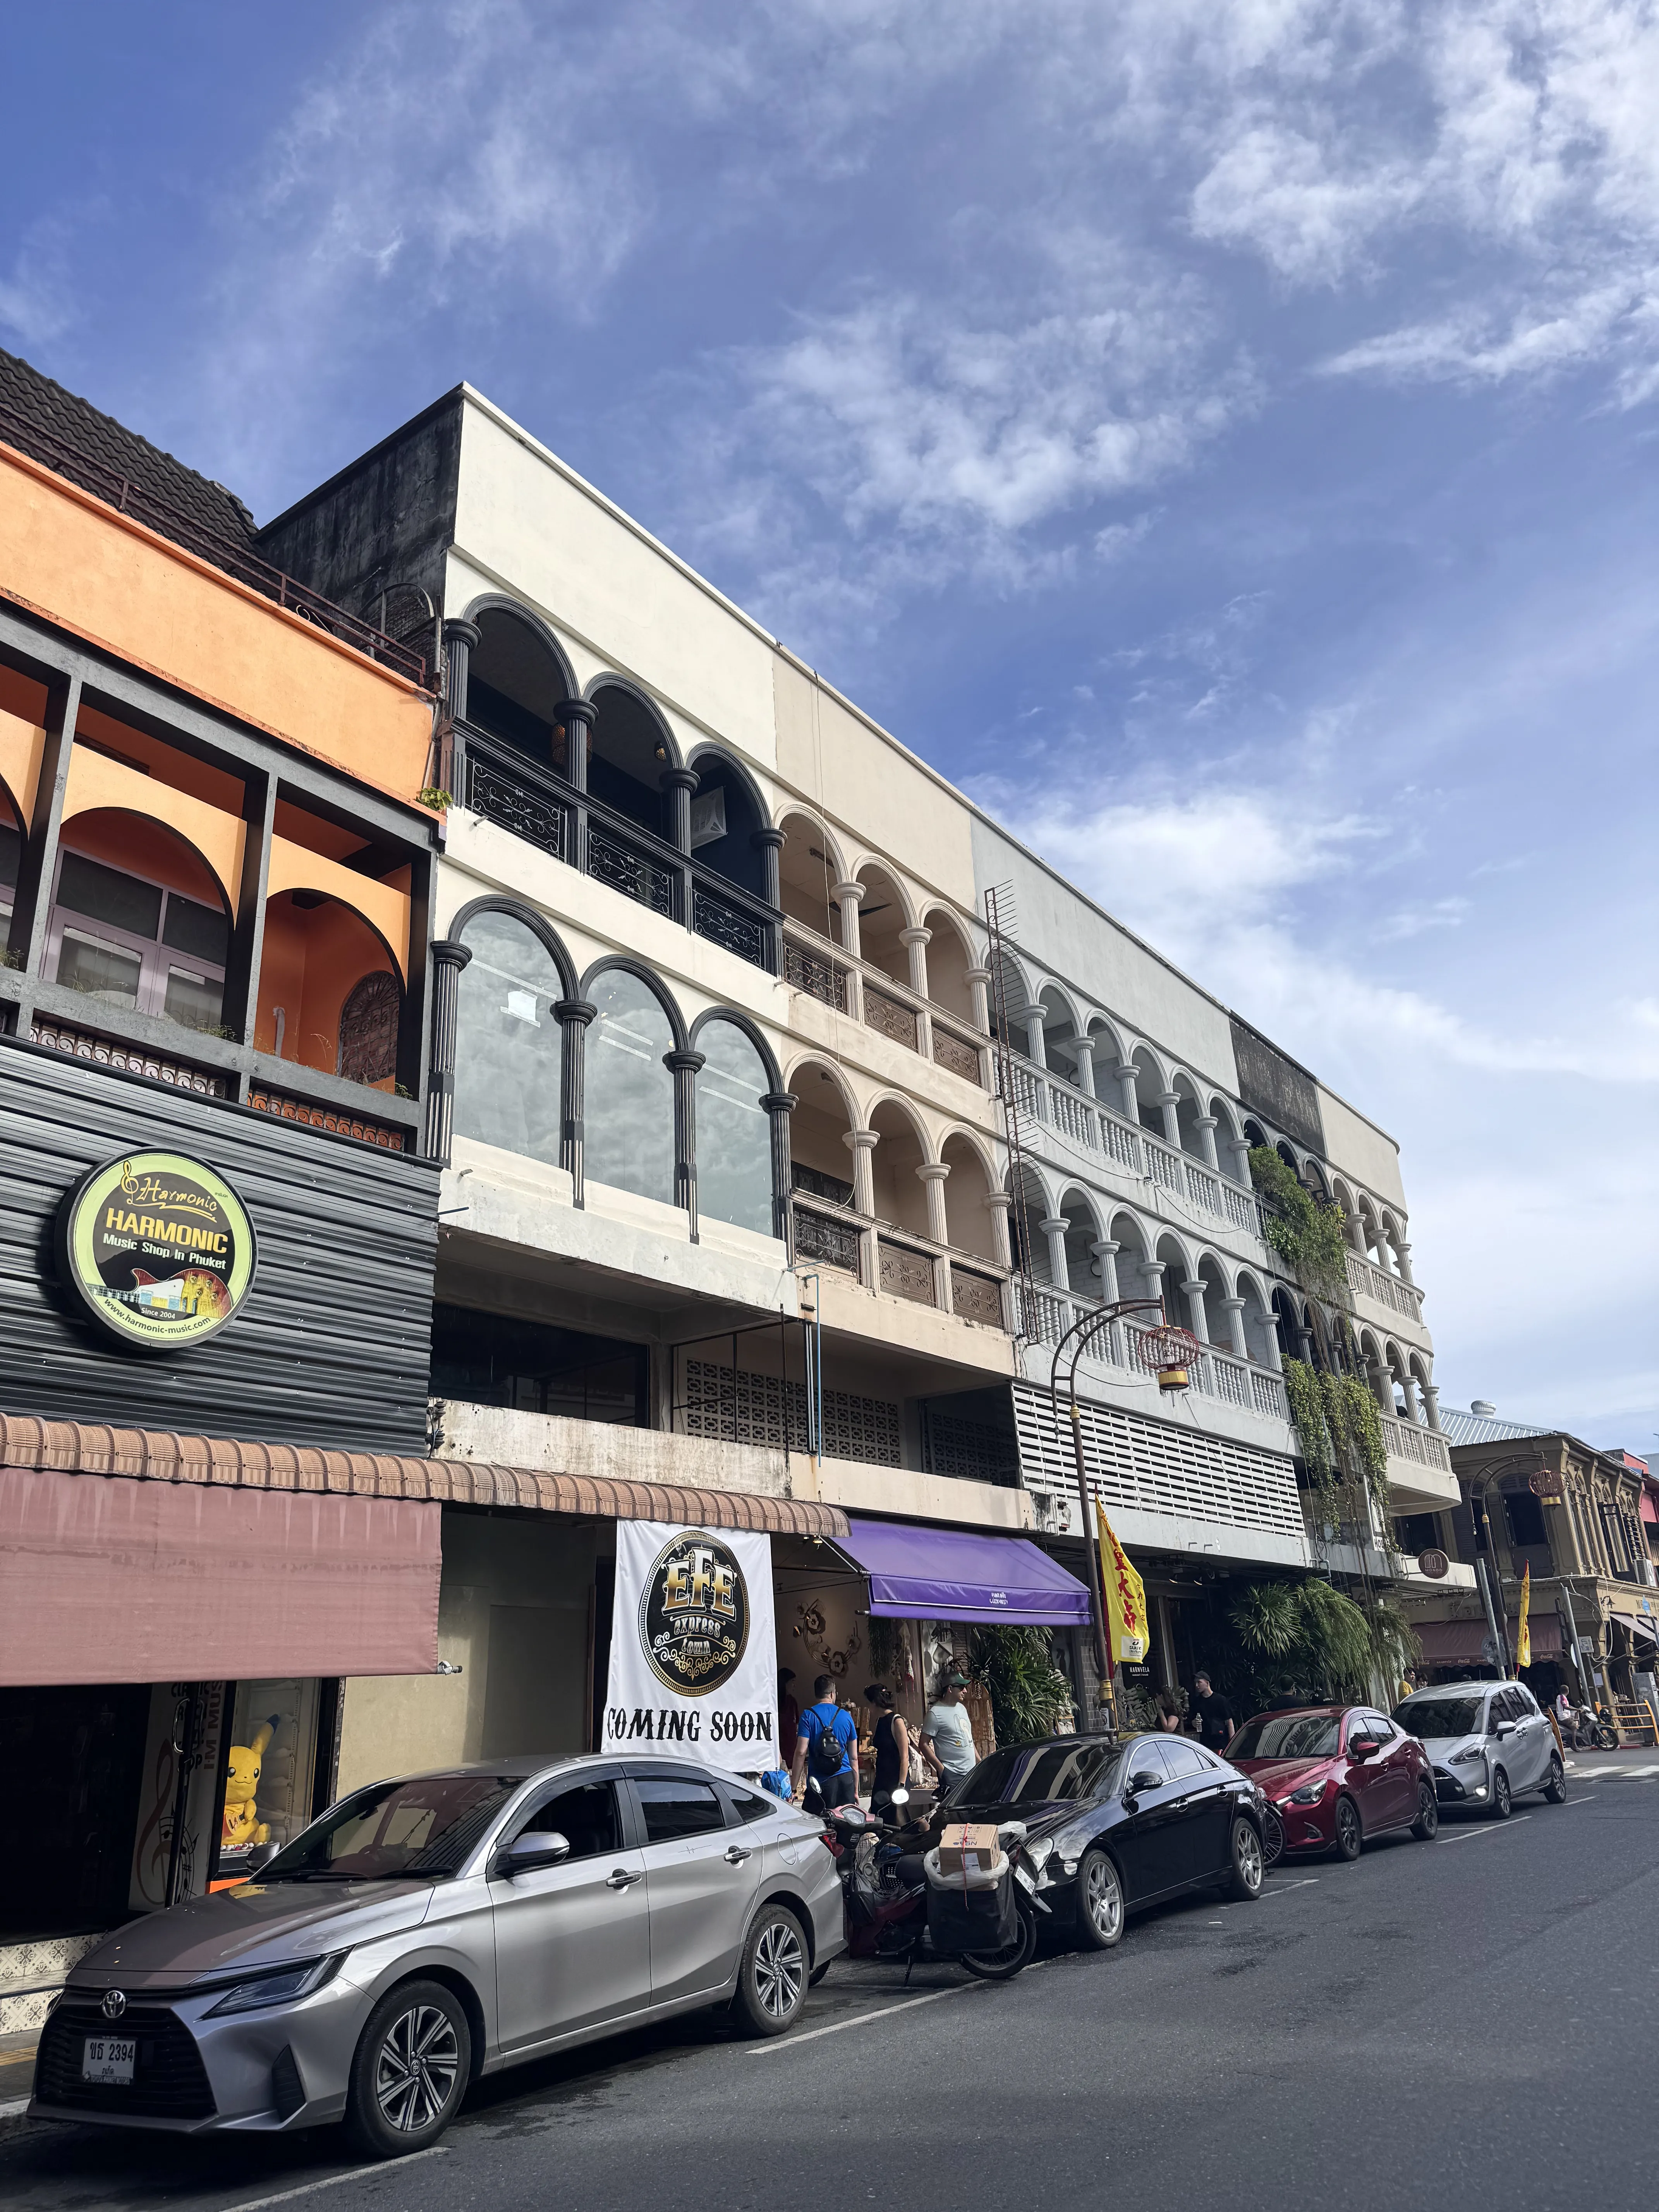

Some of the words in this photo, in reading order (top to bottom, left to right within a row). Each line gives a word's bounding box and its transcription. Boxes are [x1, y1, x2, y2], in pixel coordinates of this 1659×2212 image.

[136, 1177, 217, 1211] Harmonic
[106, 1207, 228, 1253] HARMONIC
[103, 1233, 137, 1250] Music
[142, 1242, 170, 1258] Shop
[174, 1249, 185, 1261] In
[189, 1252, 226, 1270] Phuket
[104, 1298, 211, 1333] www.harmonic-music.com
[141, 1308, 158, 1317] Since
[160, 1311, 175, 1319] 2004
[661, 1547, 736, 1621] EFE
[674, 1617, 721, 1638] express
[681, 1637, 711, 1655] town
[607, 1708, 701, 1742] COMING
[709, 1711, 773, 1742] SOON
[108, 2043, 134, 2062] 2394
